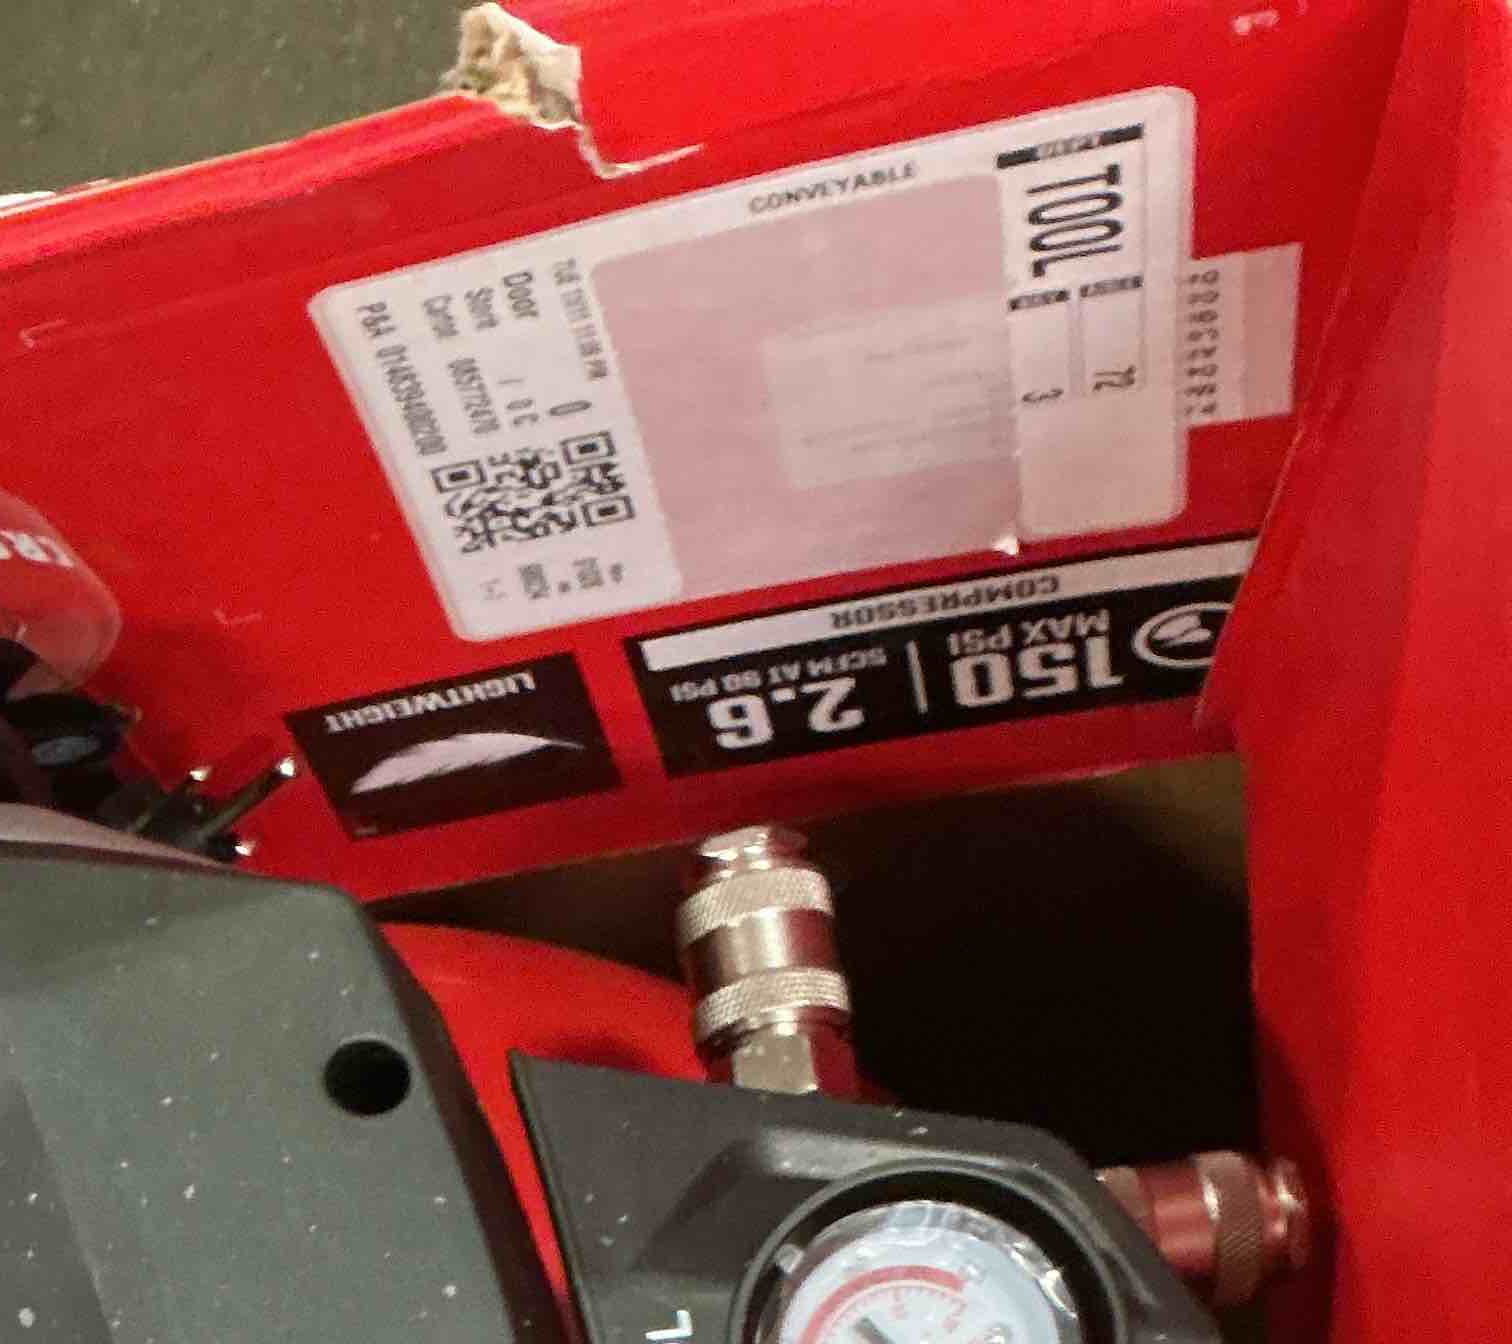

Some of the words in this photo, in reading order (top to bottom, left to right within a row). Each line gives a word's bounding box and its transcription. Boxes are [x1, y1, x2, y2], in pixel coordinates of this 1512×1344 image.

[750, 162, 921, 215] CONVEYABLE
[1026, 163, 1124, 278] TOOL
[502, 271, 539, 319] Door
[828, 574, 1061, 630] COMPRESSOR
[1020, 608, 1109, 639] MAX
[947, 623, 1013, 656] PSI
[668, 676, 716, 701] PSI
[950, 636, 1124, 707] 150
[325, 670, 536, 732] LIGHTWEIGHT
[707, 676, 864, 750] 2.6
